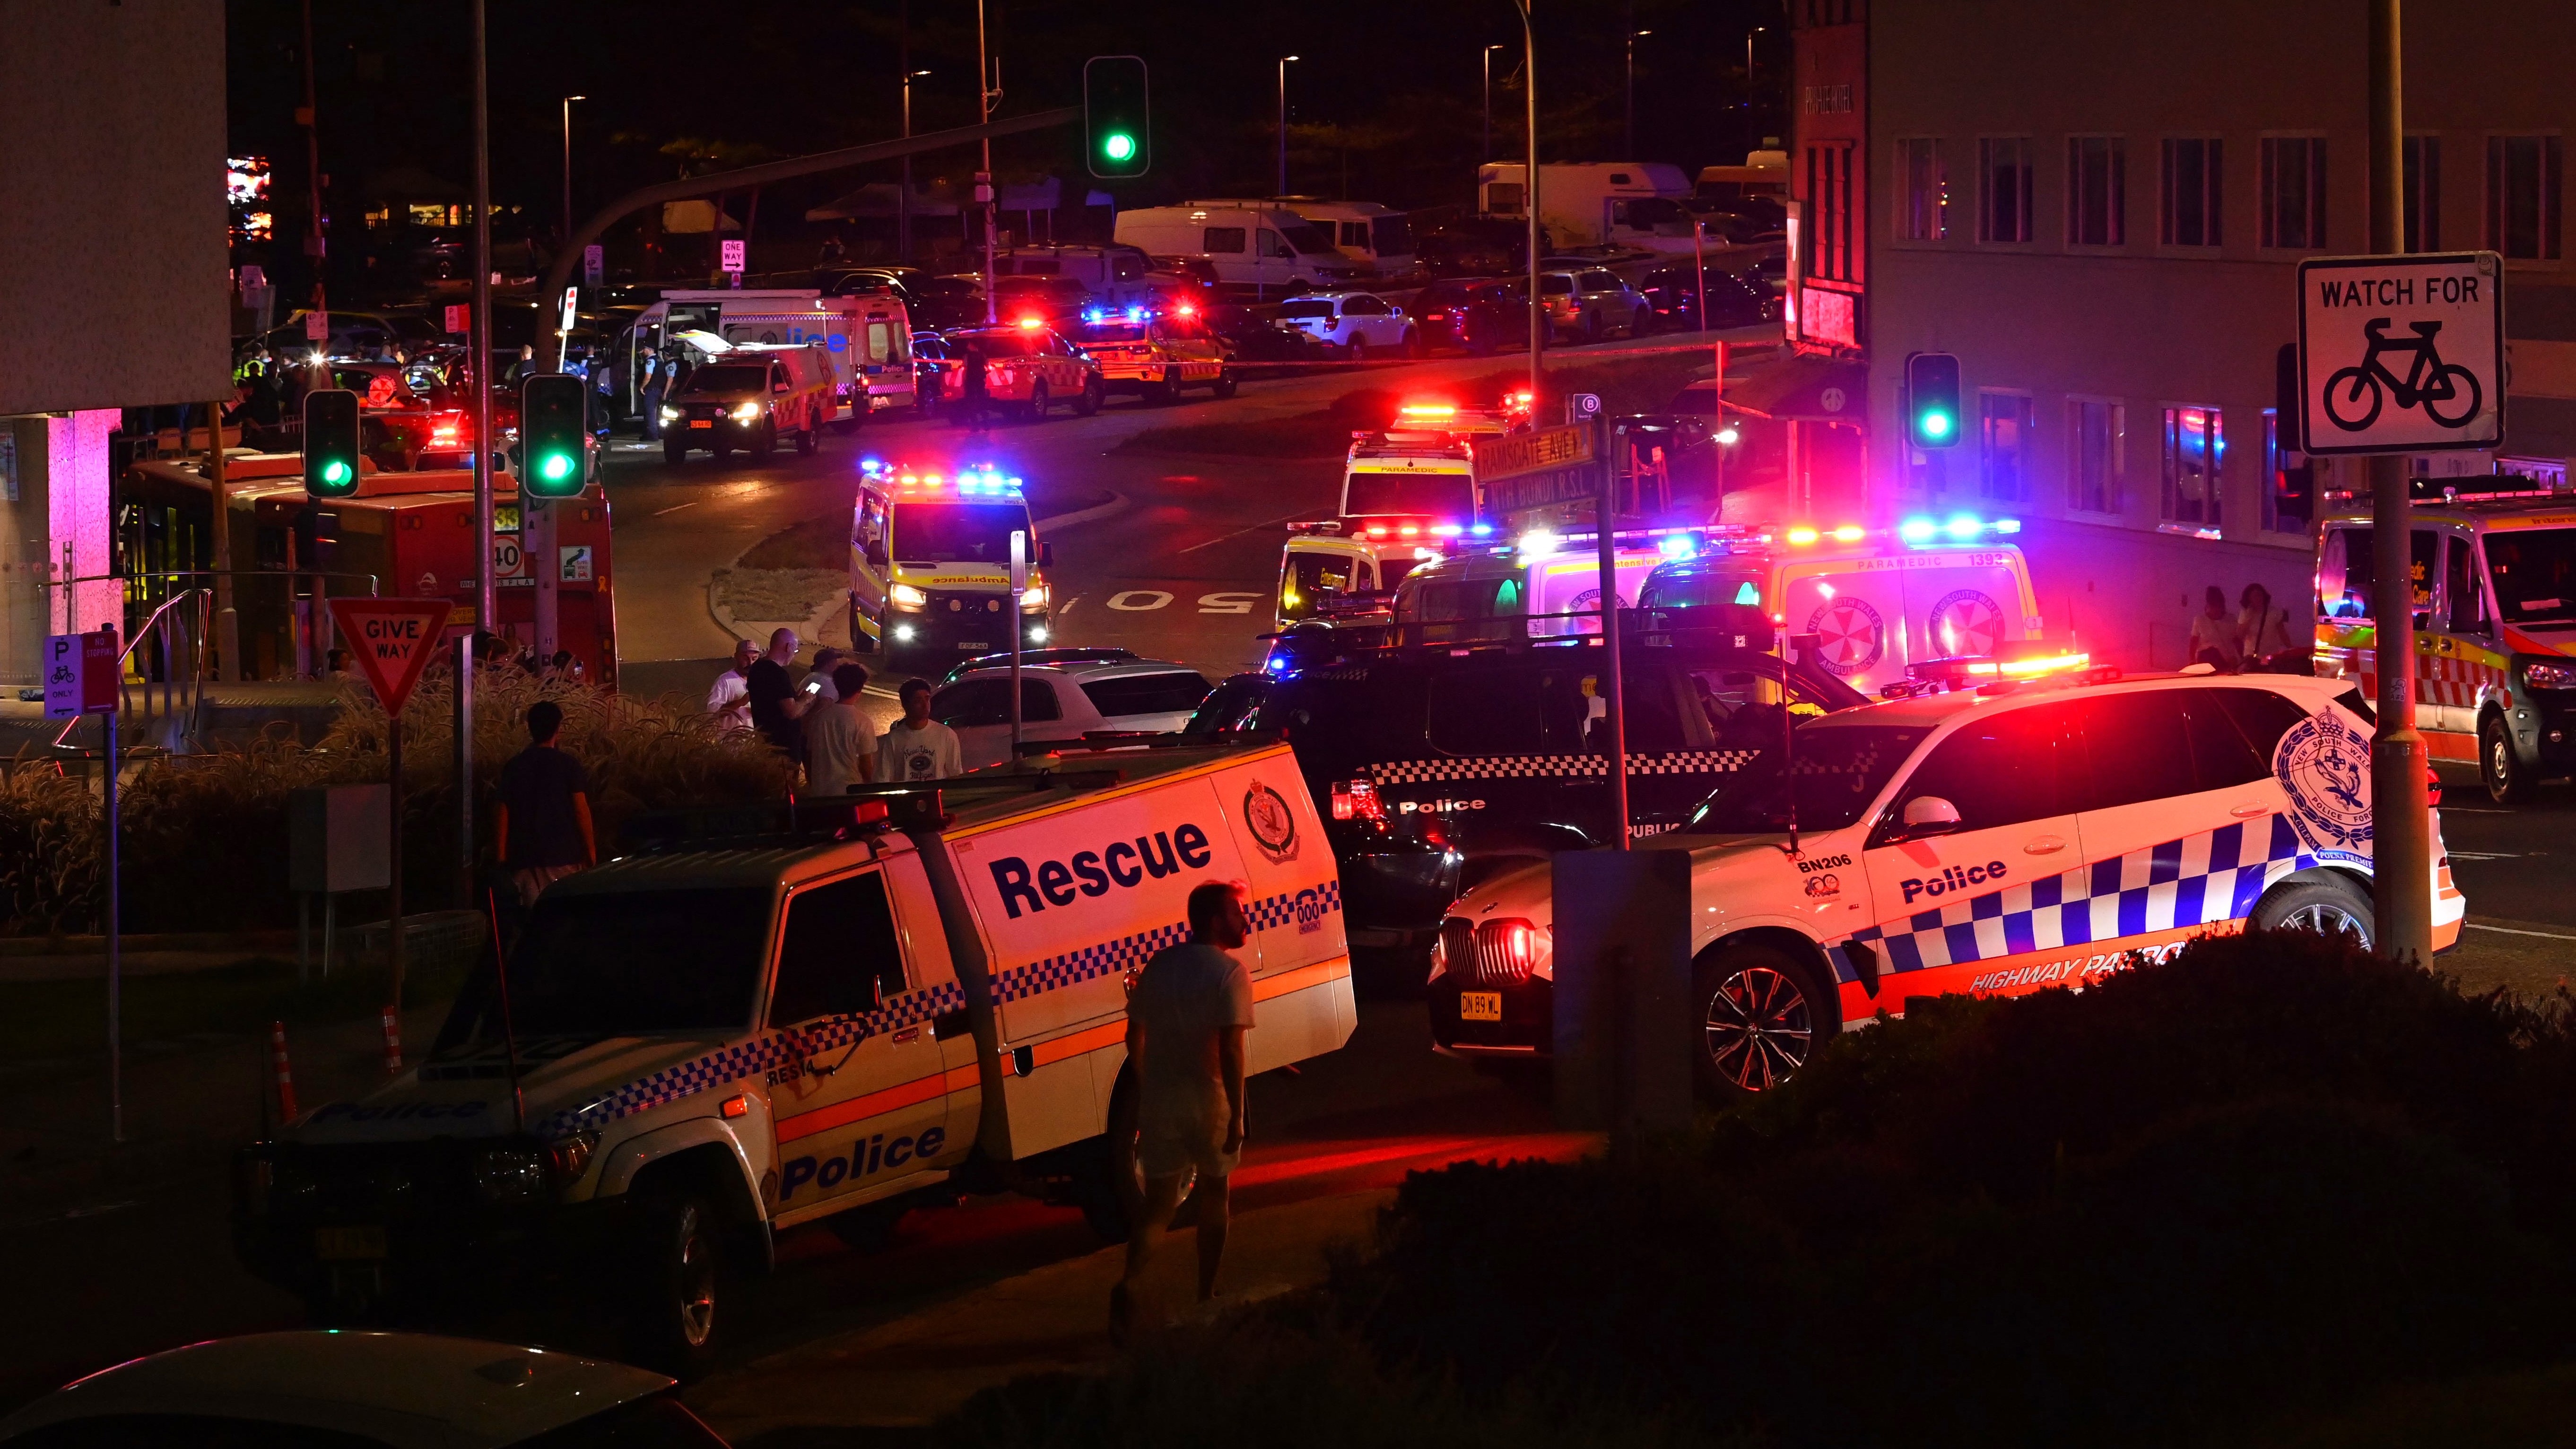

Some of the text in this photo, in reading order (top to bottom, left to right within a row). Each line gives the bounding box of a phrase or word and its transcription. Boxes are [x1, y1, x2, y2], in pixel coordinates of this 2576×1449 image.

[725, 243, 740, 251] ONE
[2321, 276, 2479, 308] WATCH FOR
[1549, 432, 1570, 461] AVE
[495, 508, 519, 527] 33
[495, 546, 519, 567] 40
[1614, 556, 1660, 568] ntensive
[1857, 556, 1942, 570] PARAMEDIC
[1580, 589, 1601, 601] SOUT
[2412, 584, 2429, 605] Care
[1808, 608, 1824, 630] NEW
[1856, 599, 1882, 629] WALES
[1932, 590, 2003, 623] NEW SOUTH WALES
[366, 619, 419, 639] GIVE
[55, 641, 70, 661] P
[95, 637, 105, 646] NO
[376, 643, 411, 659] WAY
[87, 647, 114, 658] STOPPING
[1819, 655, 1876, 675] AMBULANCE
[52, 689, 73, 698] ONLY
[2312, 739, 2341, 747] SOUTH
[2350, 747, 2371, 769] WALE
[1399, 798, 1487, 816] Police
[2312, 797, 2372, 823] POLICE FORC
[2294, 818, 2318, 850] CULPAM
[1797, 854, 1852, 873] BN206
[2319, 851, 2345, 860] POENA
[989, 823, 1211, 920] Rescue
[1900, 860, 2007, 905] Police
[1297, 902, 1320, 924] 000
[1968, 940, 2187, 993] HIGHWAY PATRO
[1462, 995, 1498, 1015] DN 89 WL
[767, 1059, 815, 1086] RES14
[310, 1100, 490, 1125] Police
[779, 1126, 946, 1202] Police
